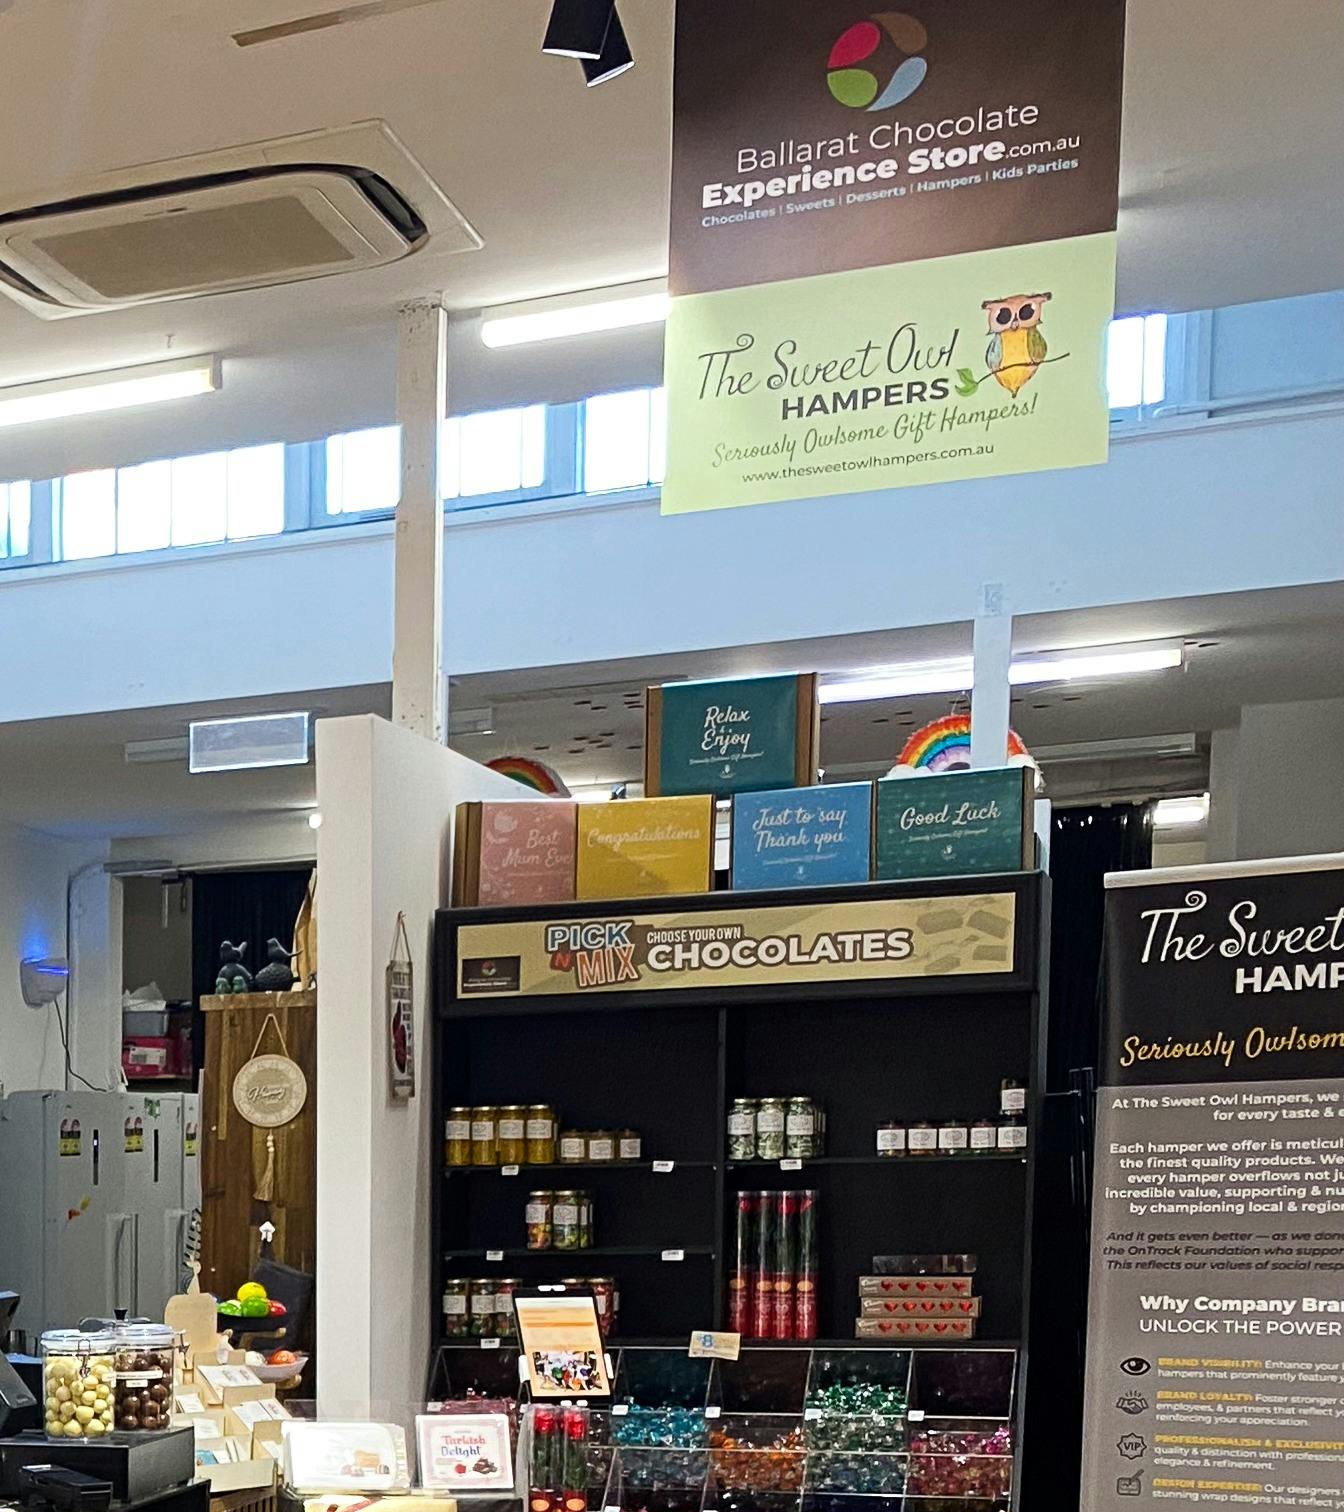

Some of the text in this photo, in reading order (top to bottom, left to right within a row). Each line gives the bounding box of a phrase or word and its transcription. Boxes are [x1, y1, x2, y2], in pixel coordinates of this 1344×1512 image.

[737, 103, 1040, 173] Ballarat Chocolate
[702, 157, 898, 209] Experience
[702, 207, 776, 228] Chocolates
[846, 185, 906, 205] Desserts
[917, 173, 982, 193] Hampers
[992, 164, 1023, 180] Kids
[1027, 157, 1078, 174] Parties
[698, 323, 960, 400] The Sweet Owl
[782, 378, 949, 420] HAMPERS
[712, 392, 1038, 468] Seriously Owlsome Gift Hampers!
[742, 444, 994, 483] www.thesweetowlhampers.com.au
[703, 705, 751, 729] Relax
[701, 729, 752, 756] Enjoy
[752, 808, 847, 831] Just to say
[900, 801, 1001, 830] Good Luck
[587, 827, 702, 852] Congratulations
[756, 828, 846, 852] Thank you
[547, 922, 633, 952] PICK
[646, 926, 742, 943] CHOOSE YOUR OWN
[1139, 890, 1344, 964] The Sweet
[645, 929, 912, 971] CHOCOLATES
[576, 943, 639, 988] MIX
[1120, 1032, 1235, 1068] Seriously
[1112, 1093, 1314, 1109] At The Sweet Owl Hampers,
[1140, 1295, 1297, 1315] Why Company
[1139, 1319, 1342, 1336] UNLOCK THE POWER
[441, 1435, 487, 1445] Turkish
[441, 1446, 482, 1457] Delight
[1124, 1441, 1141, 1451] VIP
